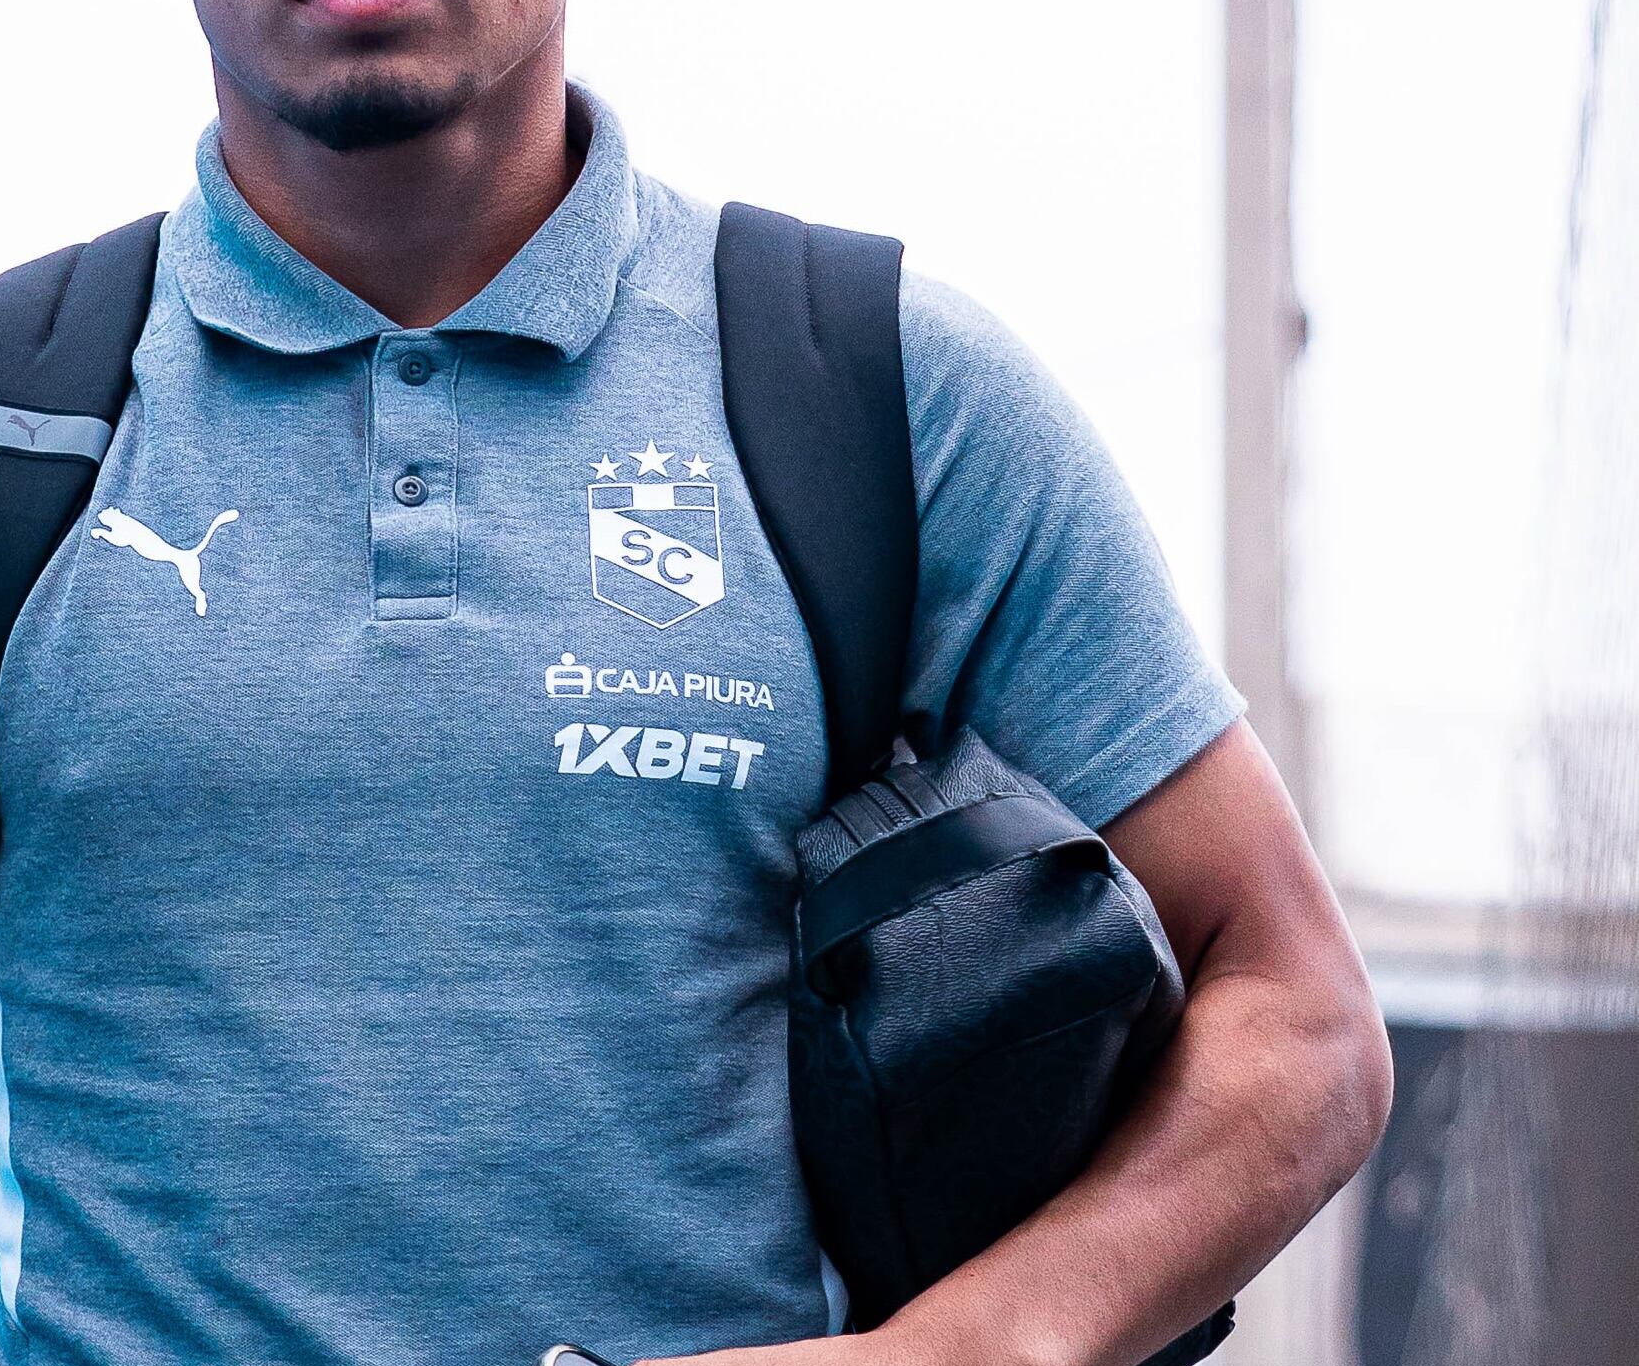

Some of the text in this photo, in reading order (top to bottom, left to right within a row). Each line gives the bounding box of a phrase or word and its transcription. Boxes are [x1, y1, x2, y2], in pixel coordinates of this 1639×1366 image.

[621, 529, 694, 585] SC
[596, 667, 775, 712] CAJA PIURA
[553, 722, 765, 791] 1XBET
